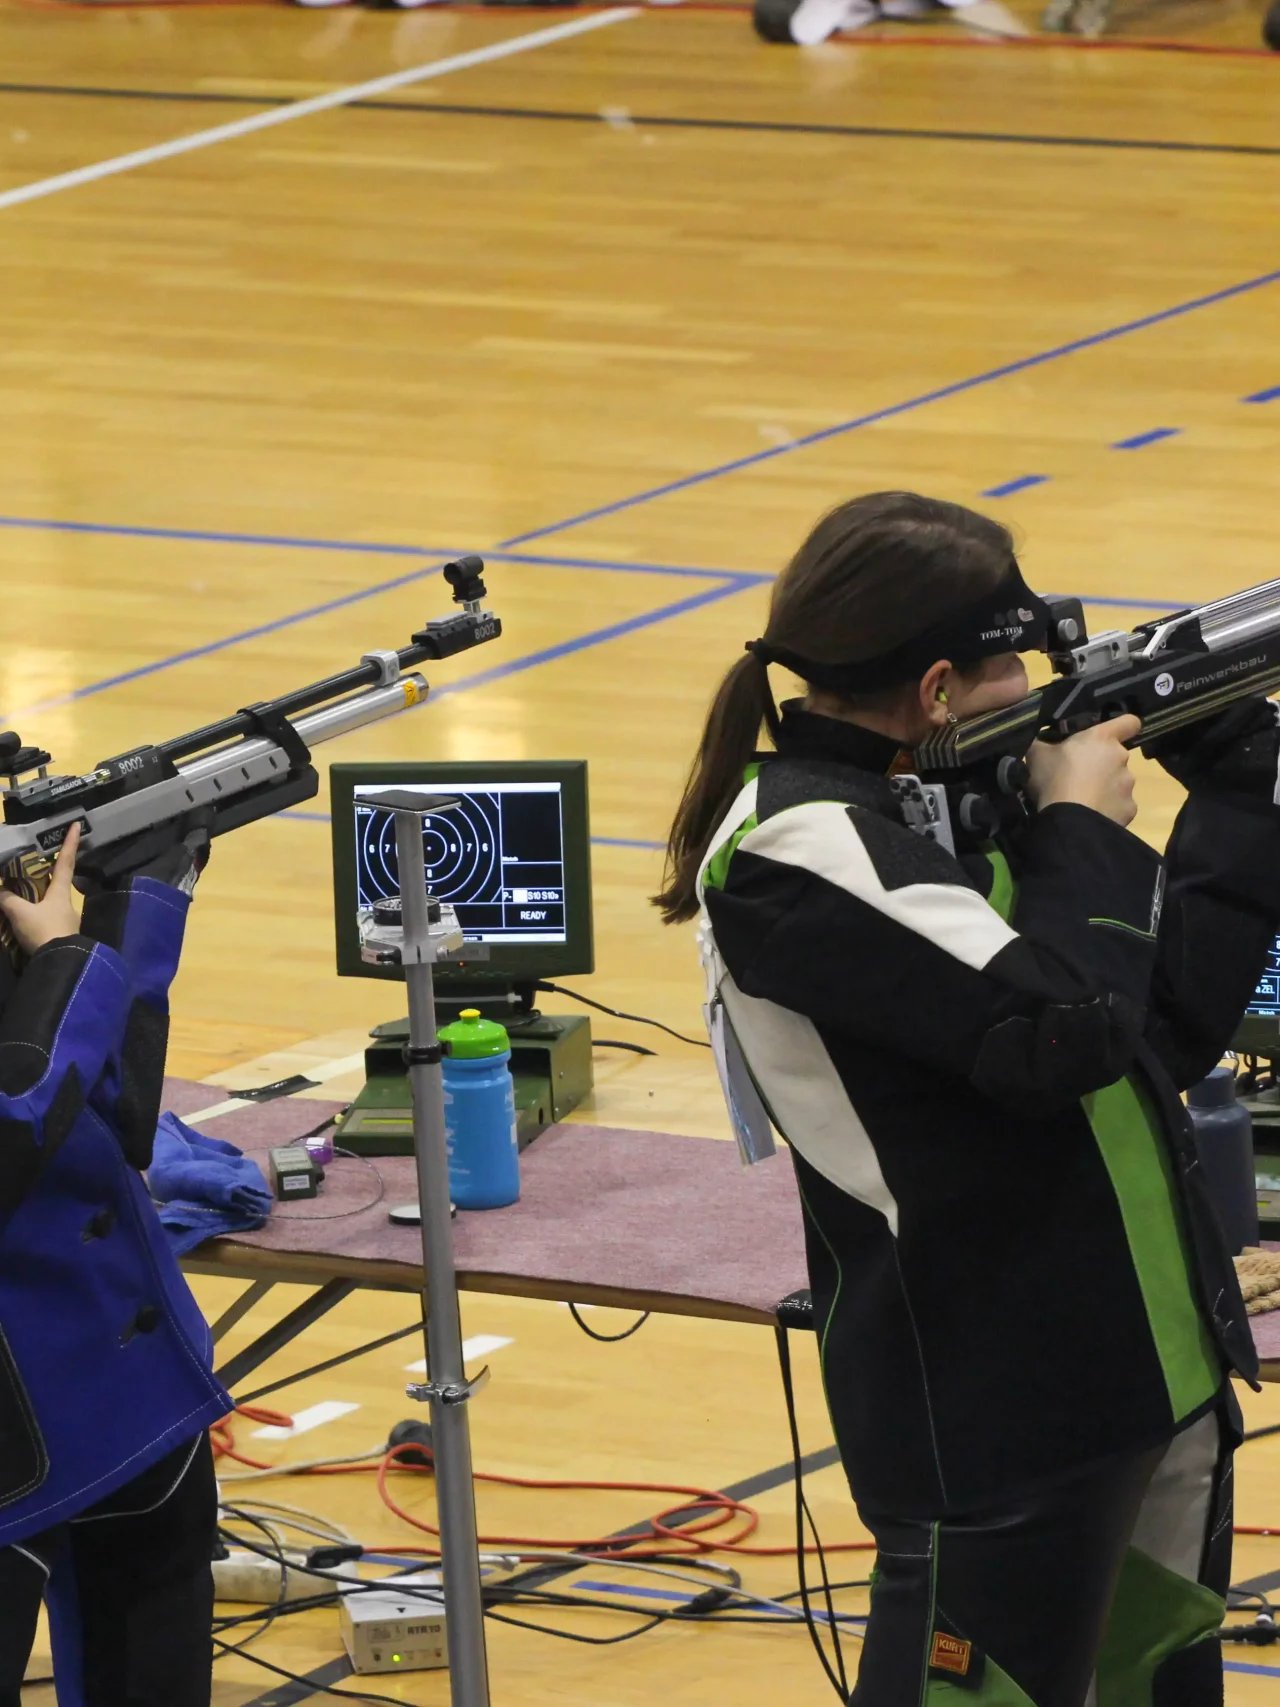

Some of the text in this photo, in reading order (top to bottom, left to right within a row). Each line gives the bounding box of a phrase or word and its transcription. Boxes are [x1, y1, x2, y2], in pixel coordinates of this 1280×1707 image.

[474, 622, 496, 640] 8002
[980, 627, 1023, 640] TOM-TOM
[1176, 654, 1267, 692] Feinwerkbau
[118, 756, 144, 774] 8002
[51, 779, 82, 796] STABILISATOR
[425, 818, 431, 828] 8
[369, 844, 390, 853] 6 7
[450, 843, 488, 852] 8 7 6
[427, 869, 432, 878] 8
[428, 886, 433, 895] 7
[520, 911, 546, 920] READY
[1262, 984, 1275, 994] ZEL
[939, 1638, 965, 1655] KURT
